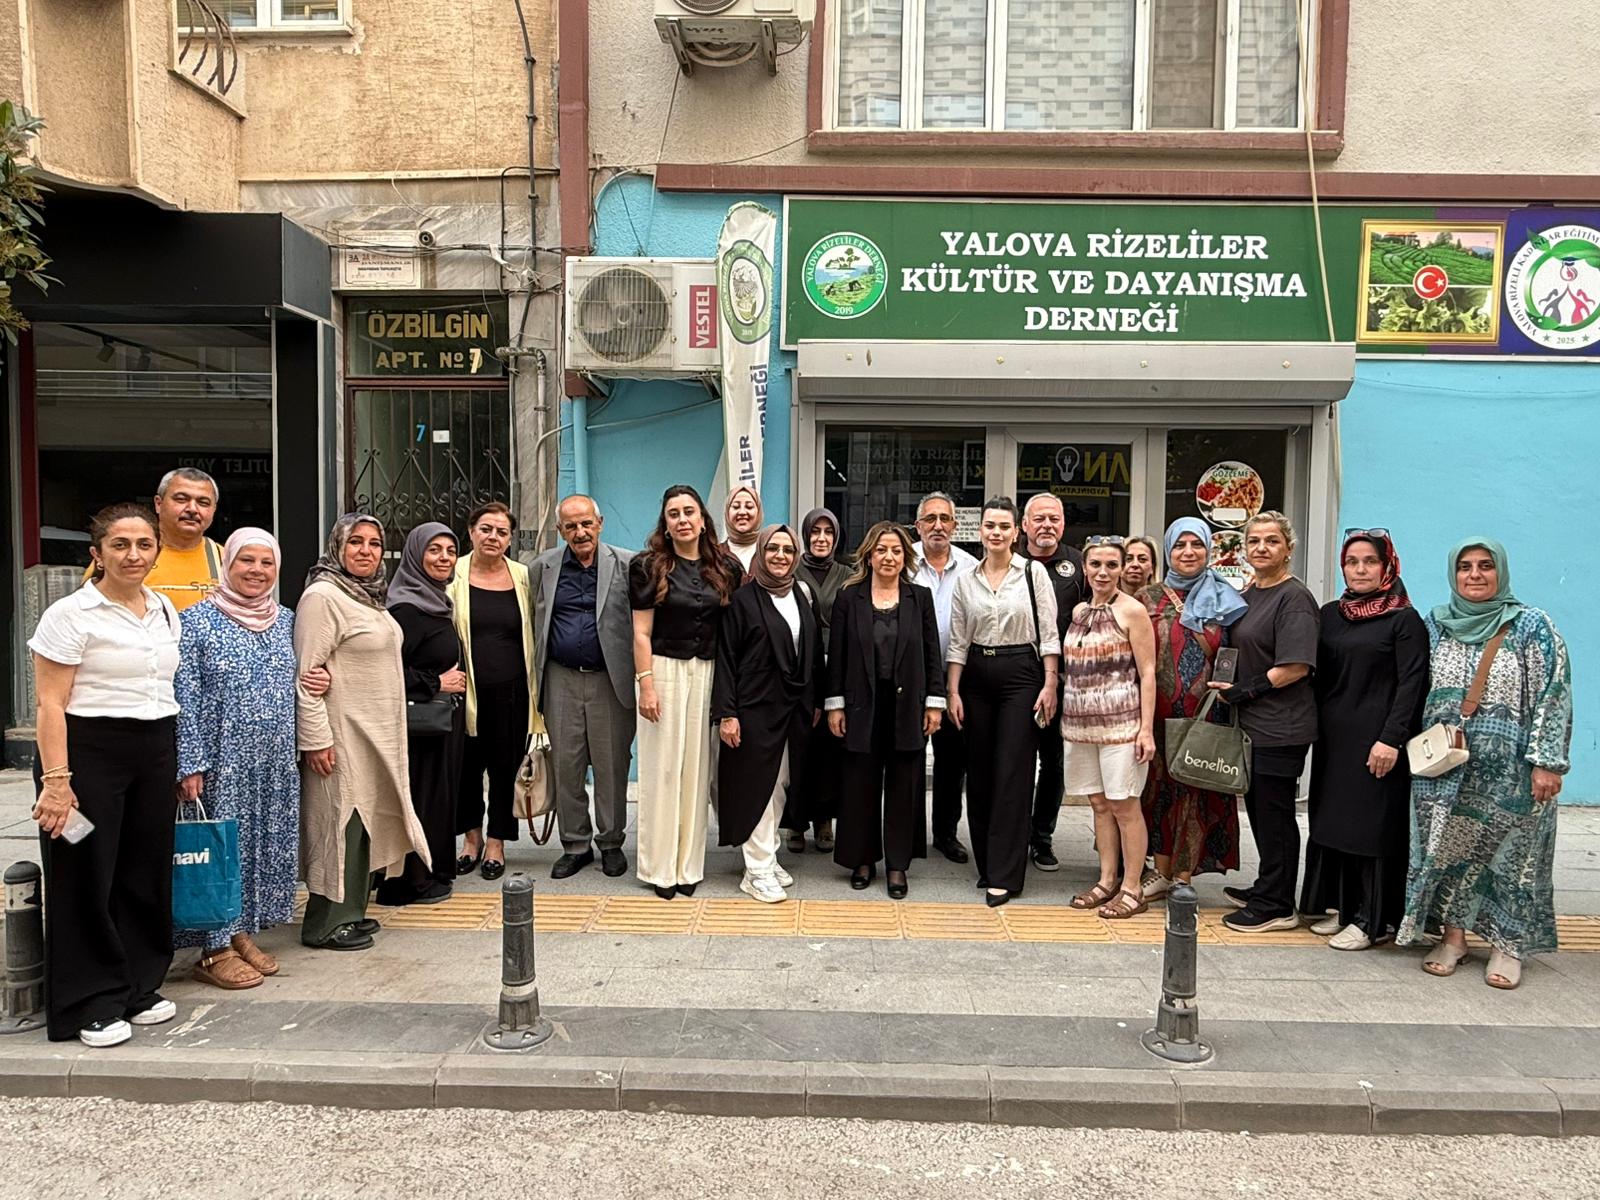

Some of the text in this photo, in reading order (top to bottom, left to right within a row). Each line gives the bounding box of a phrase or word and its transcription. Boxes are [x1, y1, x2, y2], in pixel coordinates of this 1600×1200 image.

[940, 227, 1269, 260] YALOVA RİZELİLER
[806, 250, 823, 282] YALOVA
[821, 236, 866, 251] RİZELİLER
[900, 262, 1308, 303] KÜLTÜR VE DAYANIŞMA
[368, 310, 488, 339] ÖZBİLGİN
[696, 286, 710, 347] VESTEL
[834, 306, 854, 315] 2019
[1023, 301, 1179, 332] DERNEĞİ
[1556, 336, 1576, 345] 2025
[375, 351, 428, 369] APT.
[416, 424, 426, 442] 7
[1184, 749, 1239, 776] benetton
